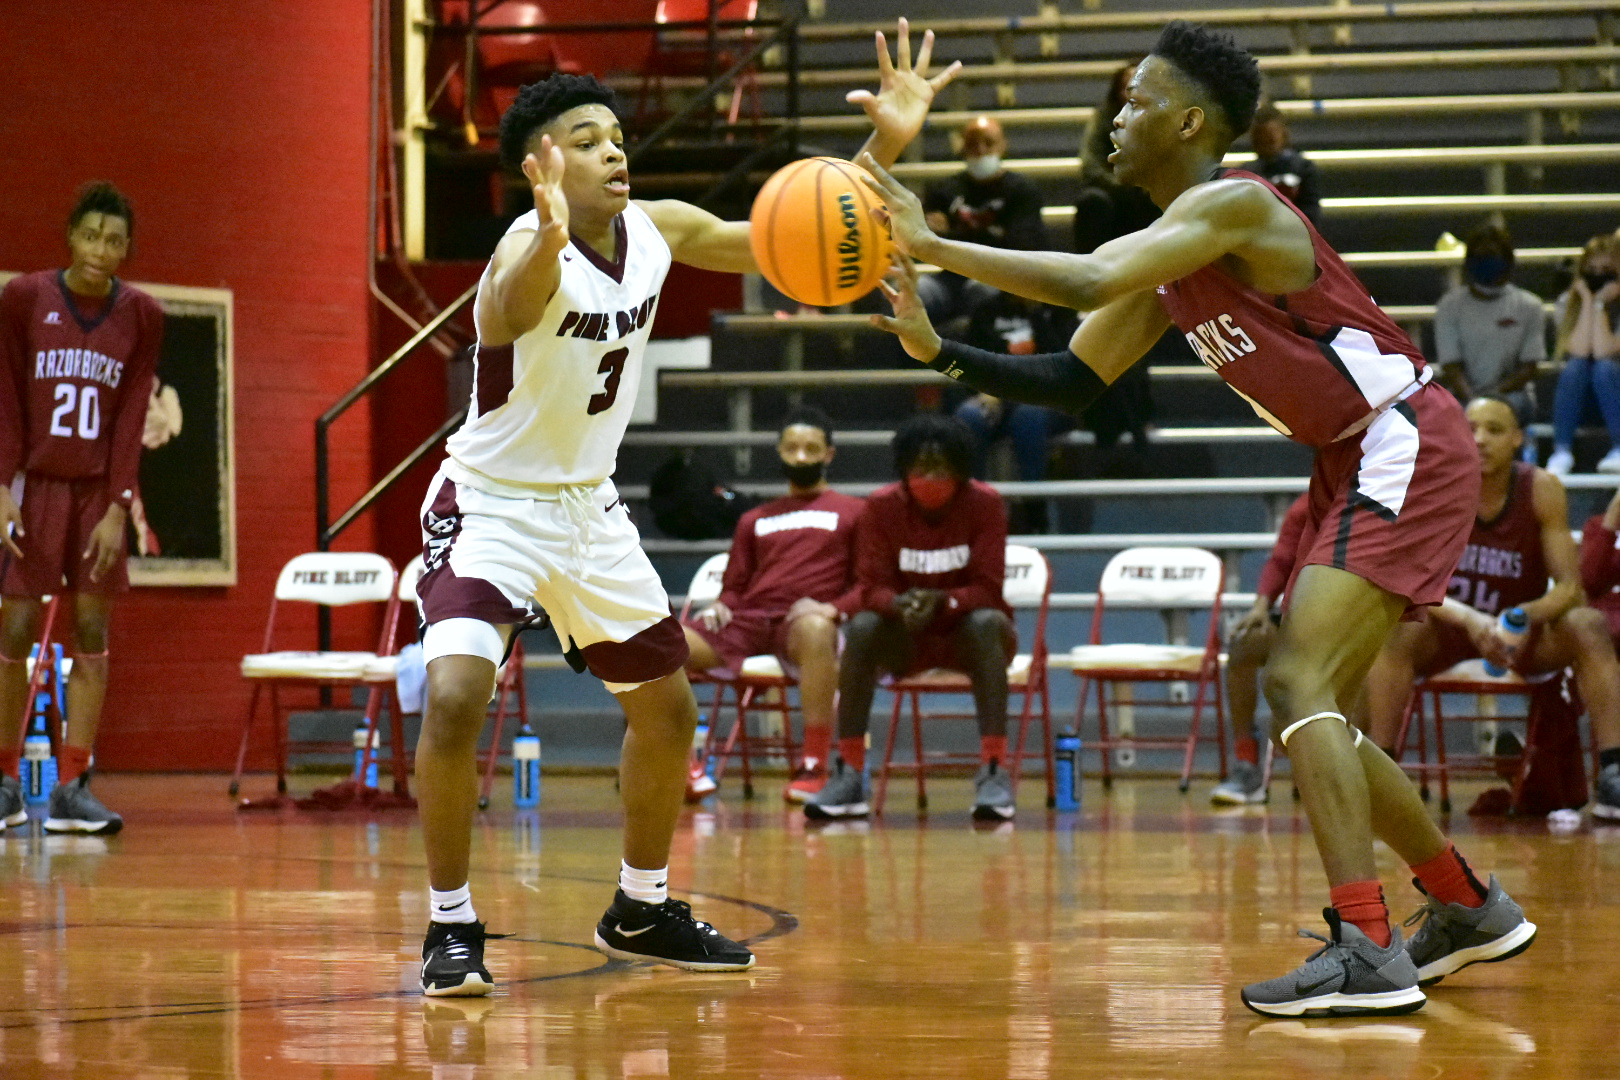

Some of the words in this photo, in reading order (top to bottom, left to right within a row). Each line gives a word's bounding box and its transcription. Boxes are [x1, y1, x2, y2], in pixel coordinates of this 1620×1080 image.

[838, 193, 861, 289] Wilson
[556, 310, 609, 342] PINE
[35, 348, 124, 390] RAZORBACKS
[586, 346, 629, 416] 3
[50, 382, 101, 441] 20
[293, 570, 328, 584] PINE
